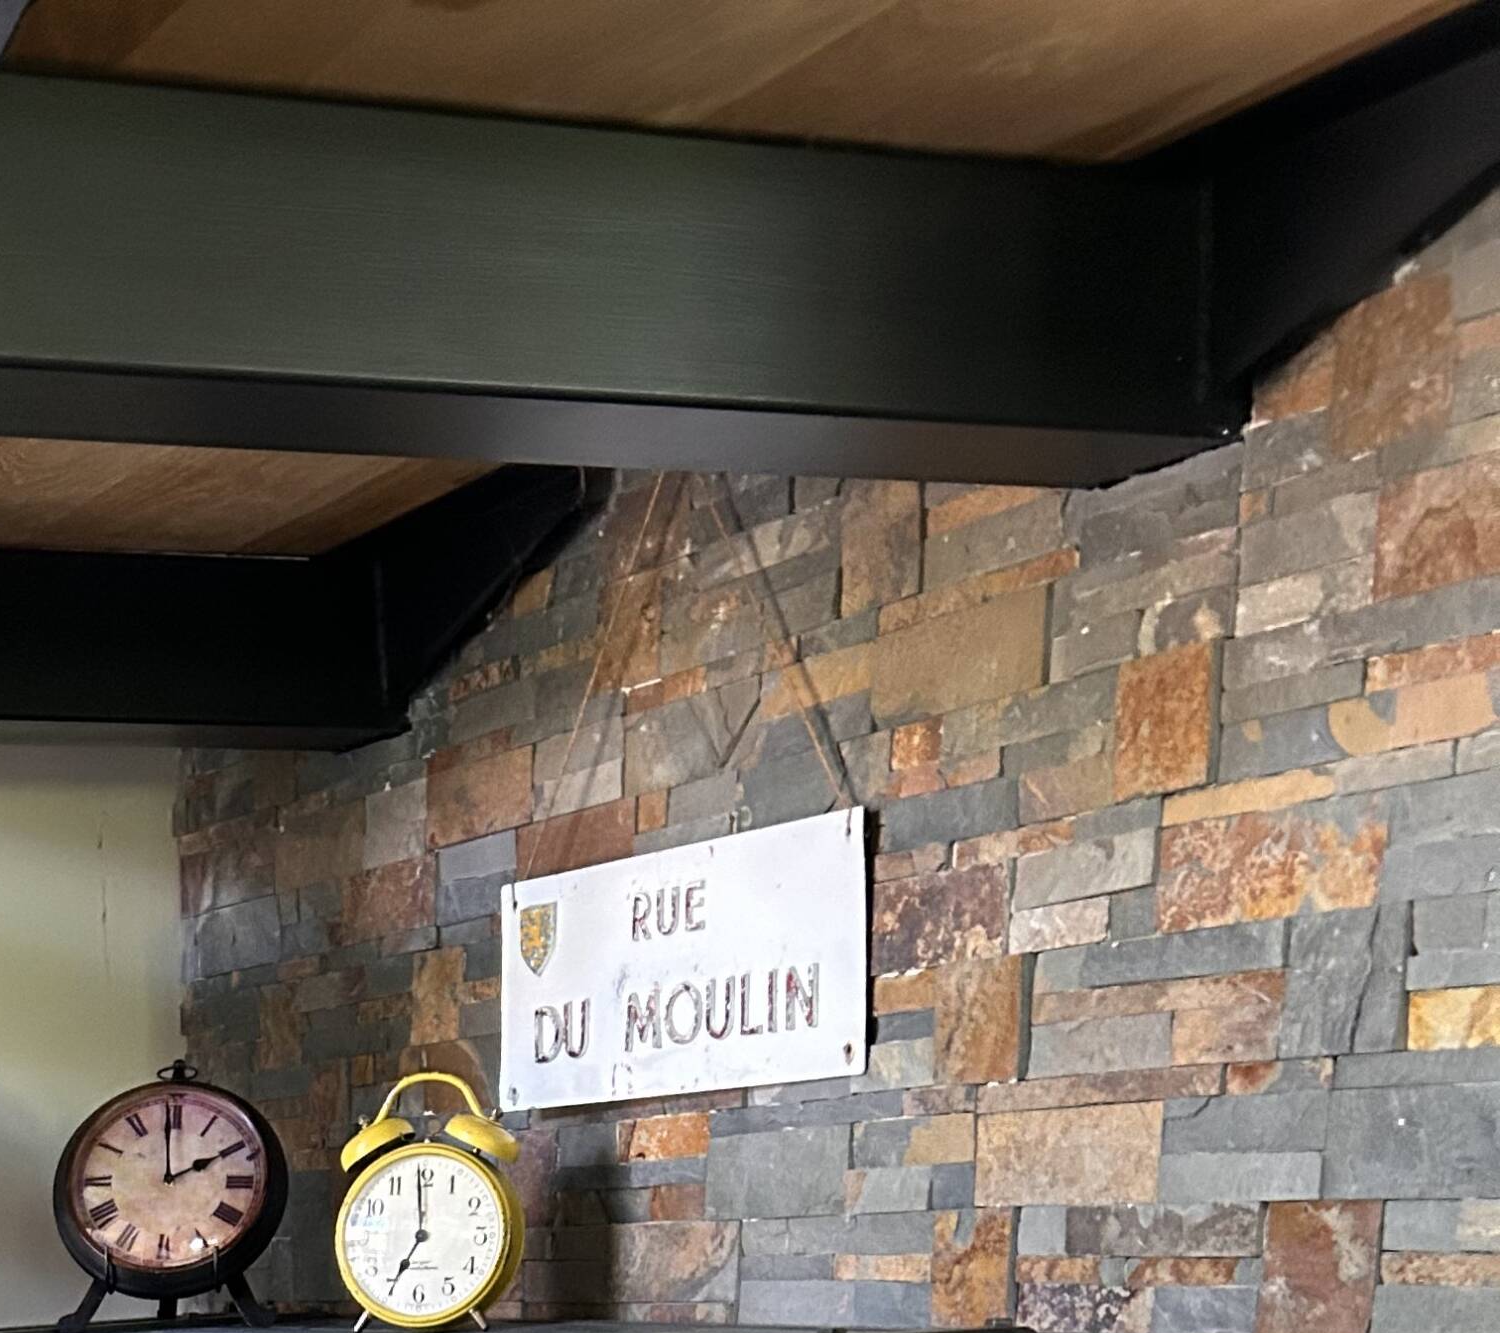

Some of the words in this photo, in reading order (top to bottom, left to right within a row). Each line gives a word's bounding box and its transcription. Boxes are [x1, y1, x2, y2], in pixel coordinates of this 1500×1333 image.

[631, 879, 706, 942] RUE
[533, 998, 591, 1064] DU
[623, 963, 820, 1053] MOULIN
[388, 1175, 402, 1195] 11
[449, 1174, 456, 1194] 1
[367, 1198, 385, 1217] 10
[467, 1196, 482, 1217] 2
[474, 1226, 488, 1246] 3
[462, 1256, 479, 1275] 4
[412, 1284, 426, 1304] 6
[441, 1276, 456, 1296] 5
